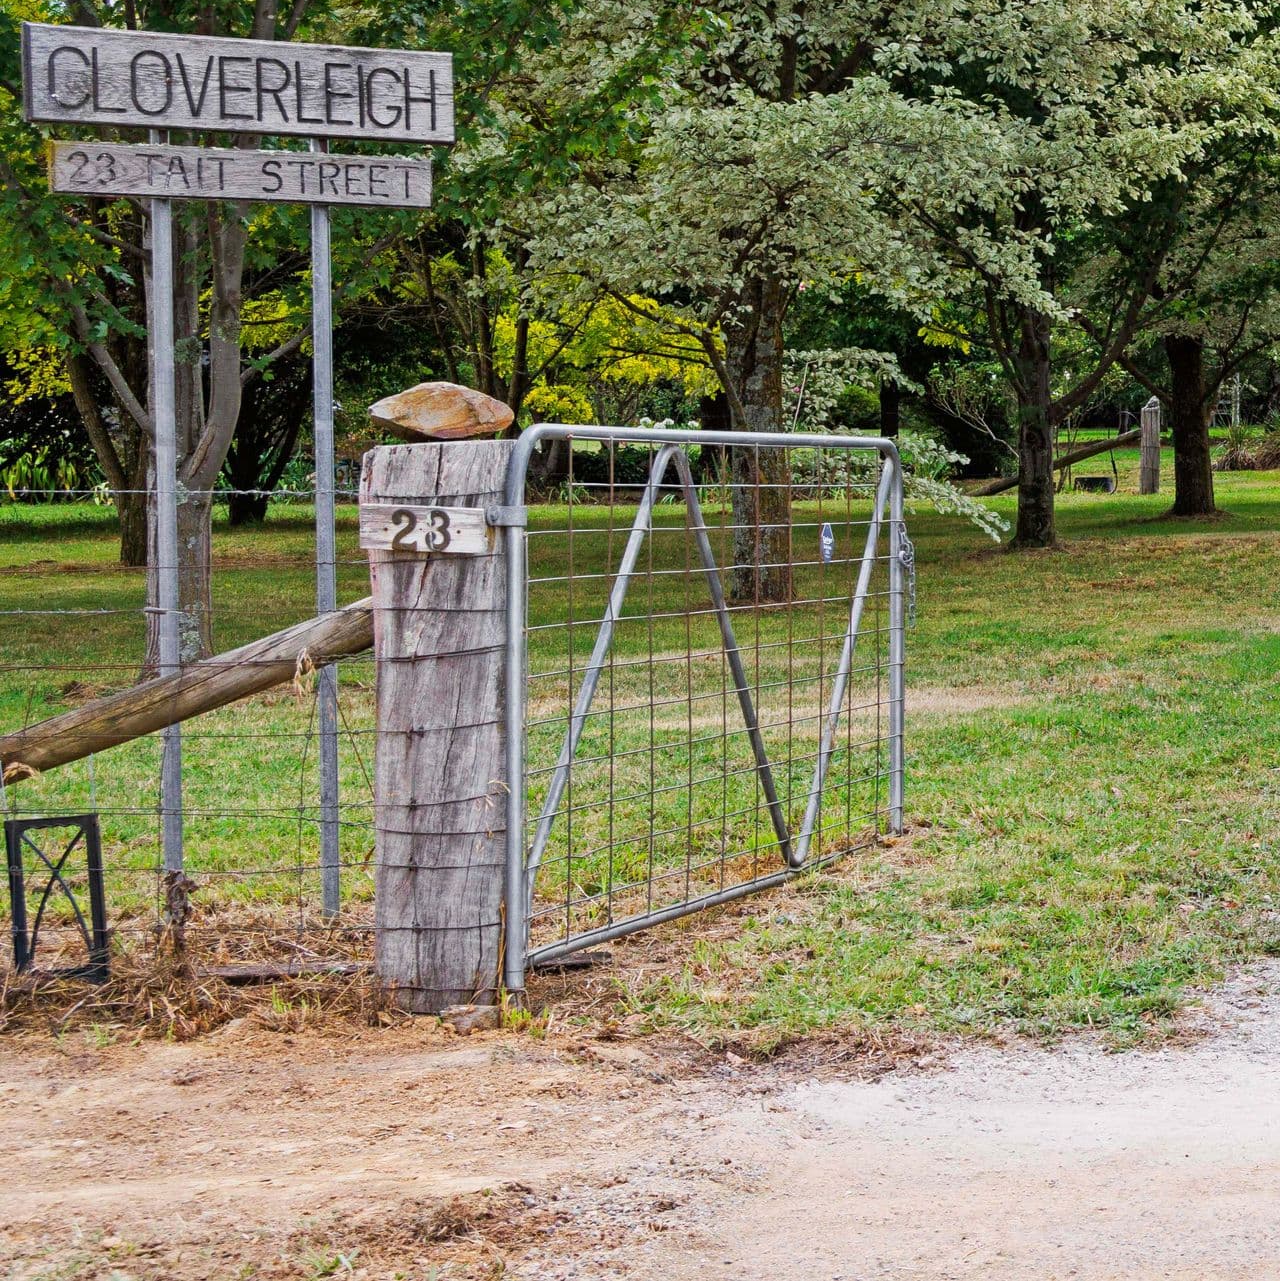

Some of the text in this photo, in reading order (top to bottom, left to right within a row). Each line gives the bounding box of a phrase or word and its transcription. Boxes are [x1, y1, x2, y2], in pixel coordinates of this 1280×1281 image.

[47, 46, 437, 132] CLOVERLEIGH
[67, 151, 420, 199] 23 TAIT STREET
[391, 509, 451, 552] 23
